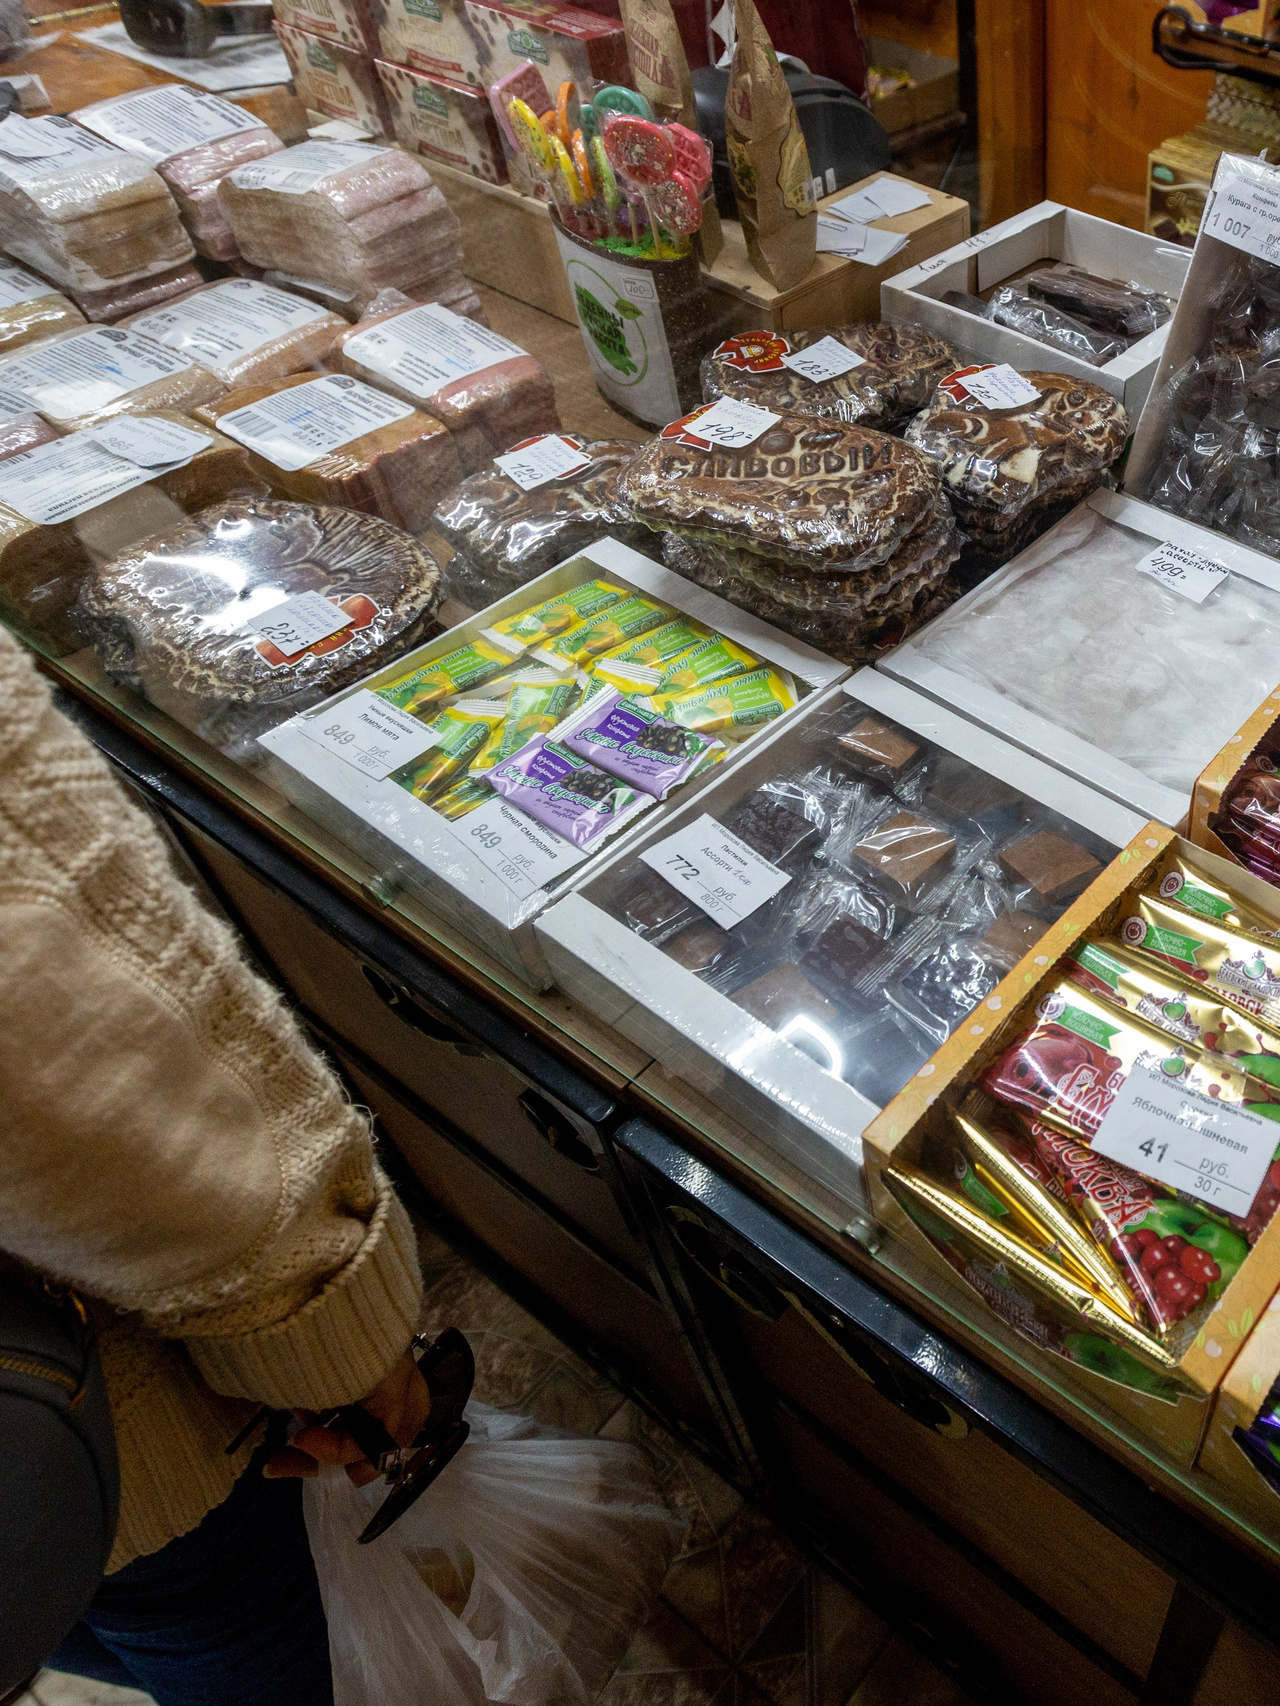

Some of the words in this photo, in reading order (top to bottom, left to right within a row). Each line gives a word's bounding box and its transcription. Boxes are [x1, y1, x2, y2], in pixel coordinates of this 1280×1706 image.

[1228, 194, 1251, 210] Курага
[1252, 193, 1278, 208] Конфеты
[1224, 217, 1251, 239] 007
[689, 633, 724, 660] Умные
[732, 668, 771, 689] Умные
[669, 684, 730, 718] вкусняшки
[358, 713, 382, 730] Лимон
[382, 728, 400, 741] мята
[368, 704, 386, 718] Умные
[385, 715, 414, 735] вкусняшки
[323, 724, 355, 745] 849
[367, 745, 390, 759] руб.
[620, 740, 684, 766] вкусняшки
[542, 781, 610, 814] вкусняшки
[471, 824, 502, 849] 849
[500, 805, 522, 829] Черная
[521, 826, 558, 860] смородина
[534, 821, 561, 844] вкусняшки
[700, 846, 732, 872] Ассорти
[711, 822, 720, 831] ИП
[719, 828, 741, 846] Морозова
[739, 841, 753, 857] Лидия
[752, 853, 780, 876] Васильевна
[721, 845, 748, 867] Пастилки
[512, 854, 535, 870] руб.
[666, 854, 700, 880] 772
[700, 893, 719, 909] 800
[713, 886, 737, 903] руб.
[1148, 1073, 1160, 1082] ИП
[1162, 1077, 1196, 1097] Морозова
[1197, 1091, 1220, 1108] Лидия
[1219, 1103, 1263, 1126] Васильевна
[1139, 1137, 1169, 1164] 41
[1199, 1157, 1229, 1179] руб.
[1194, 1177, 1212, 1192] 30
